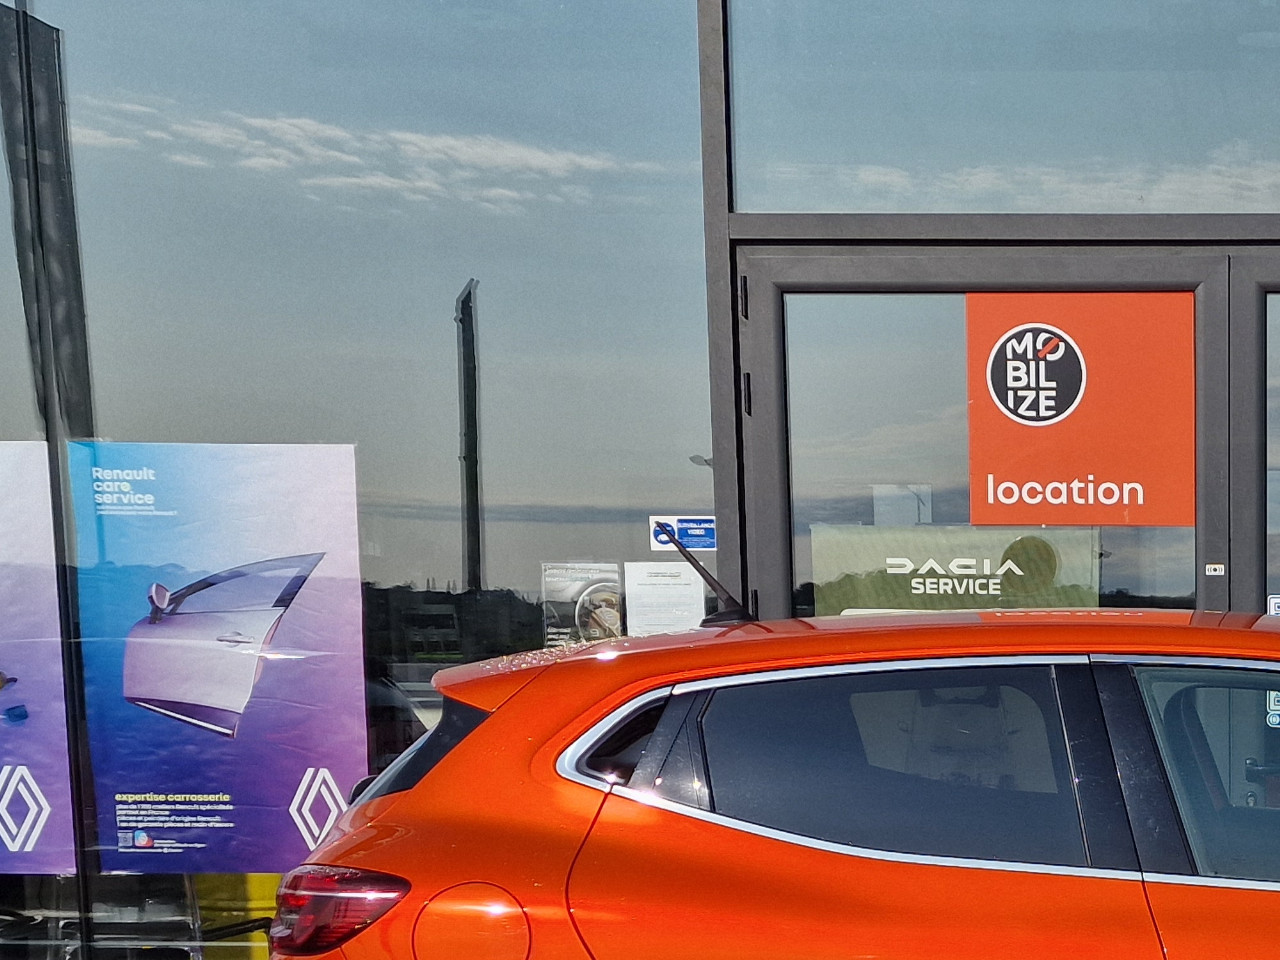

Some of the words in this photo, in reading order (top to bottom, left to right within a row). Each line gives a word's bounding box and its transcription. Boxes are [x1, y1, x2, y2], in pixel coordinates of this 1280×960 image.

[92, 467, 156, 480] Renault
[93, 481, 131, 492] care
[987, 474, 1144, 505] location
[94, 491, 155, 504] service
[886, 557, 1025, 576] DACIA
[911, 578, 1001, 595] SERVICE
[115, 792, 166, 803] expertise
[167, 792, 230, 801] carrosserie
